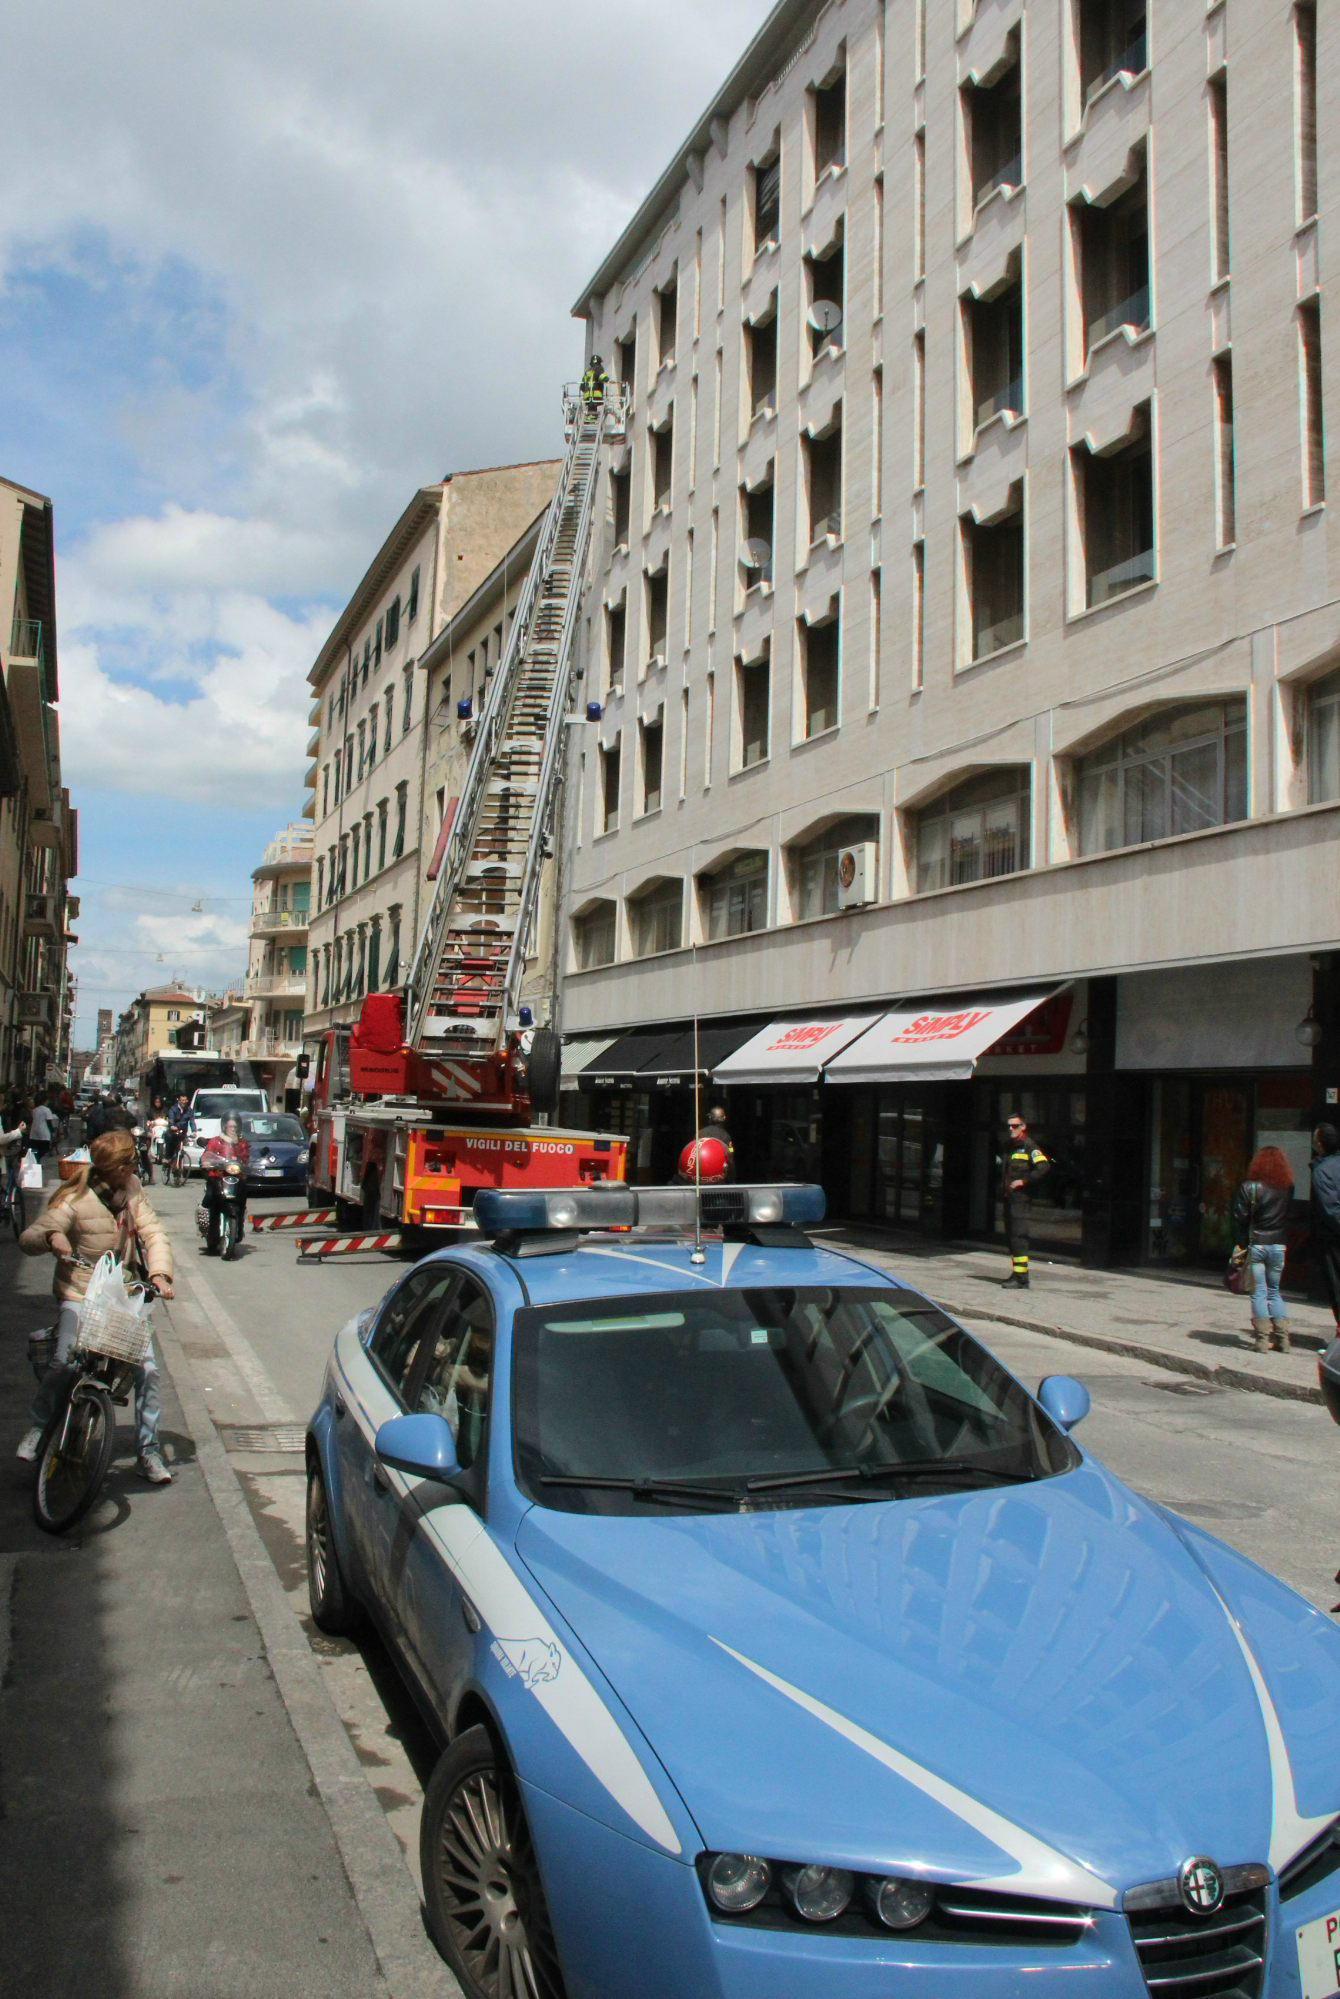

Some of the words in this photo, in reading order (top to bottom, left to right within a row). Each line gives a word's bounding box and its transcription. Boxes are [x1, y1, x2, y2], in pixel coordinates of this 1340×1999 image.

[466, 1138, 500, 1150] VIGILI
[505, 1140, 528, 1152] DEL
[532, 1142, 574, 1155] FUOCO
